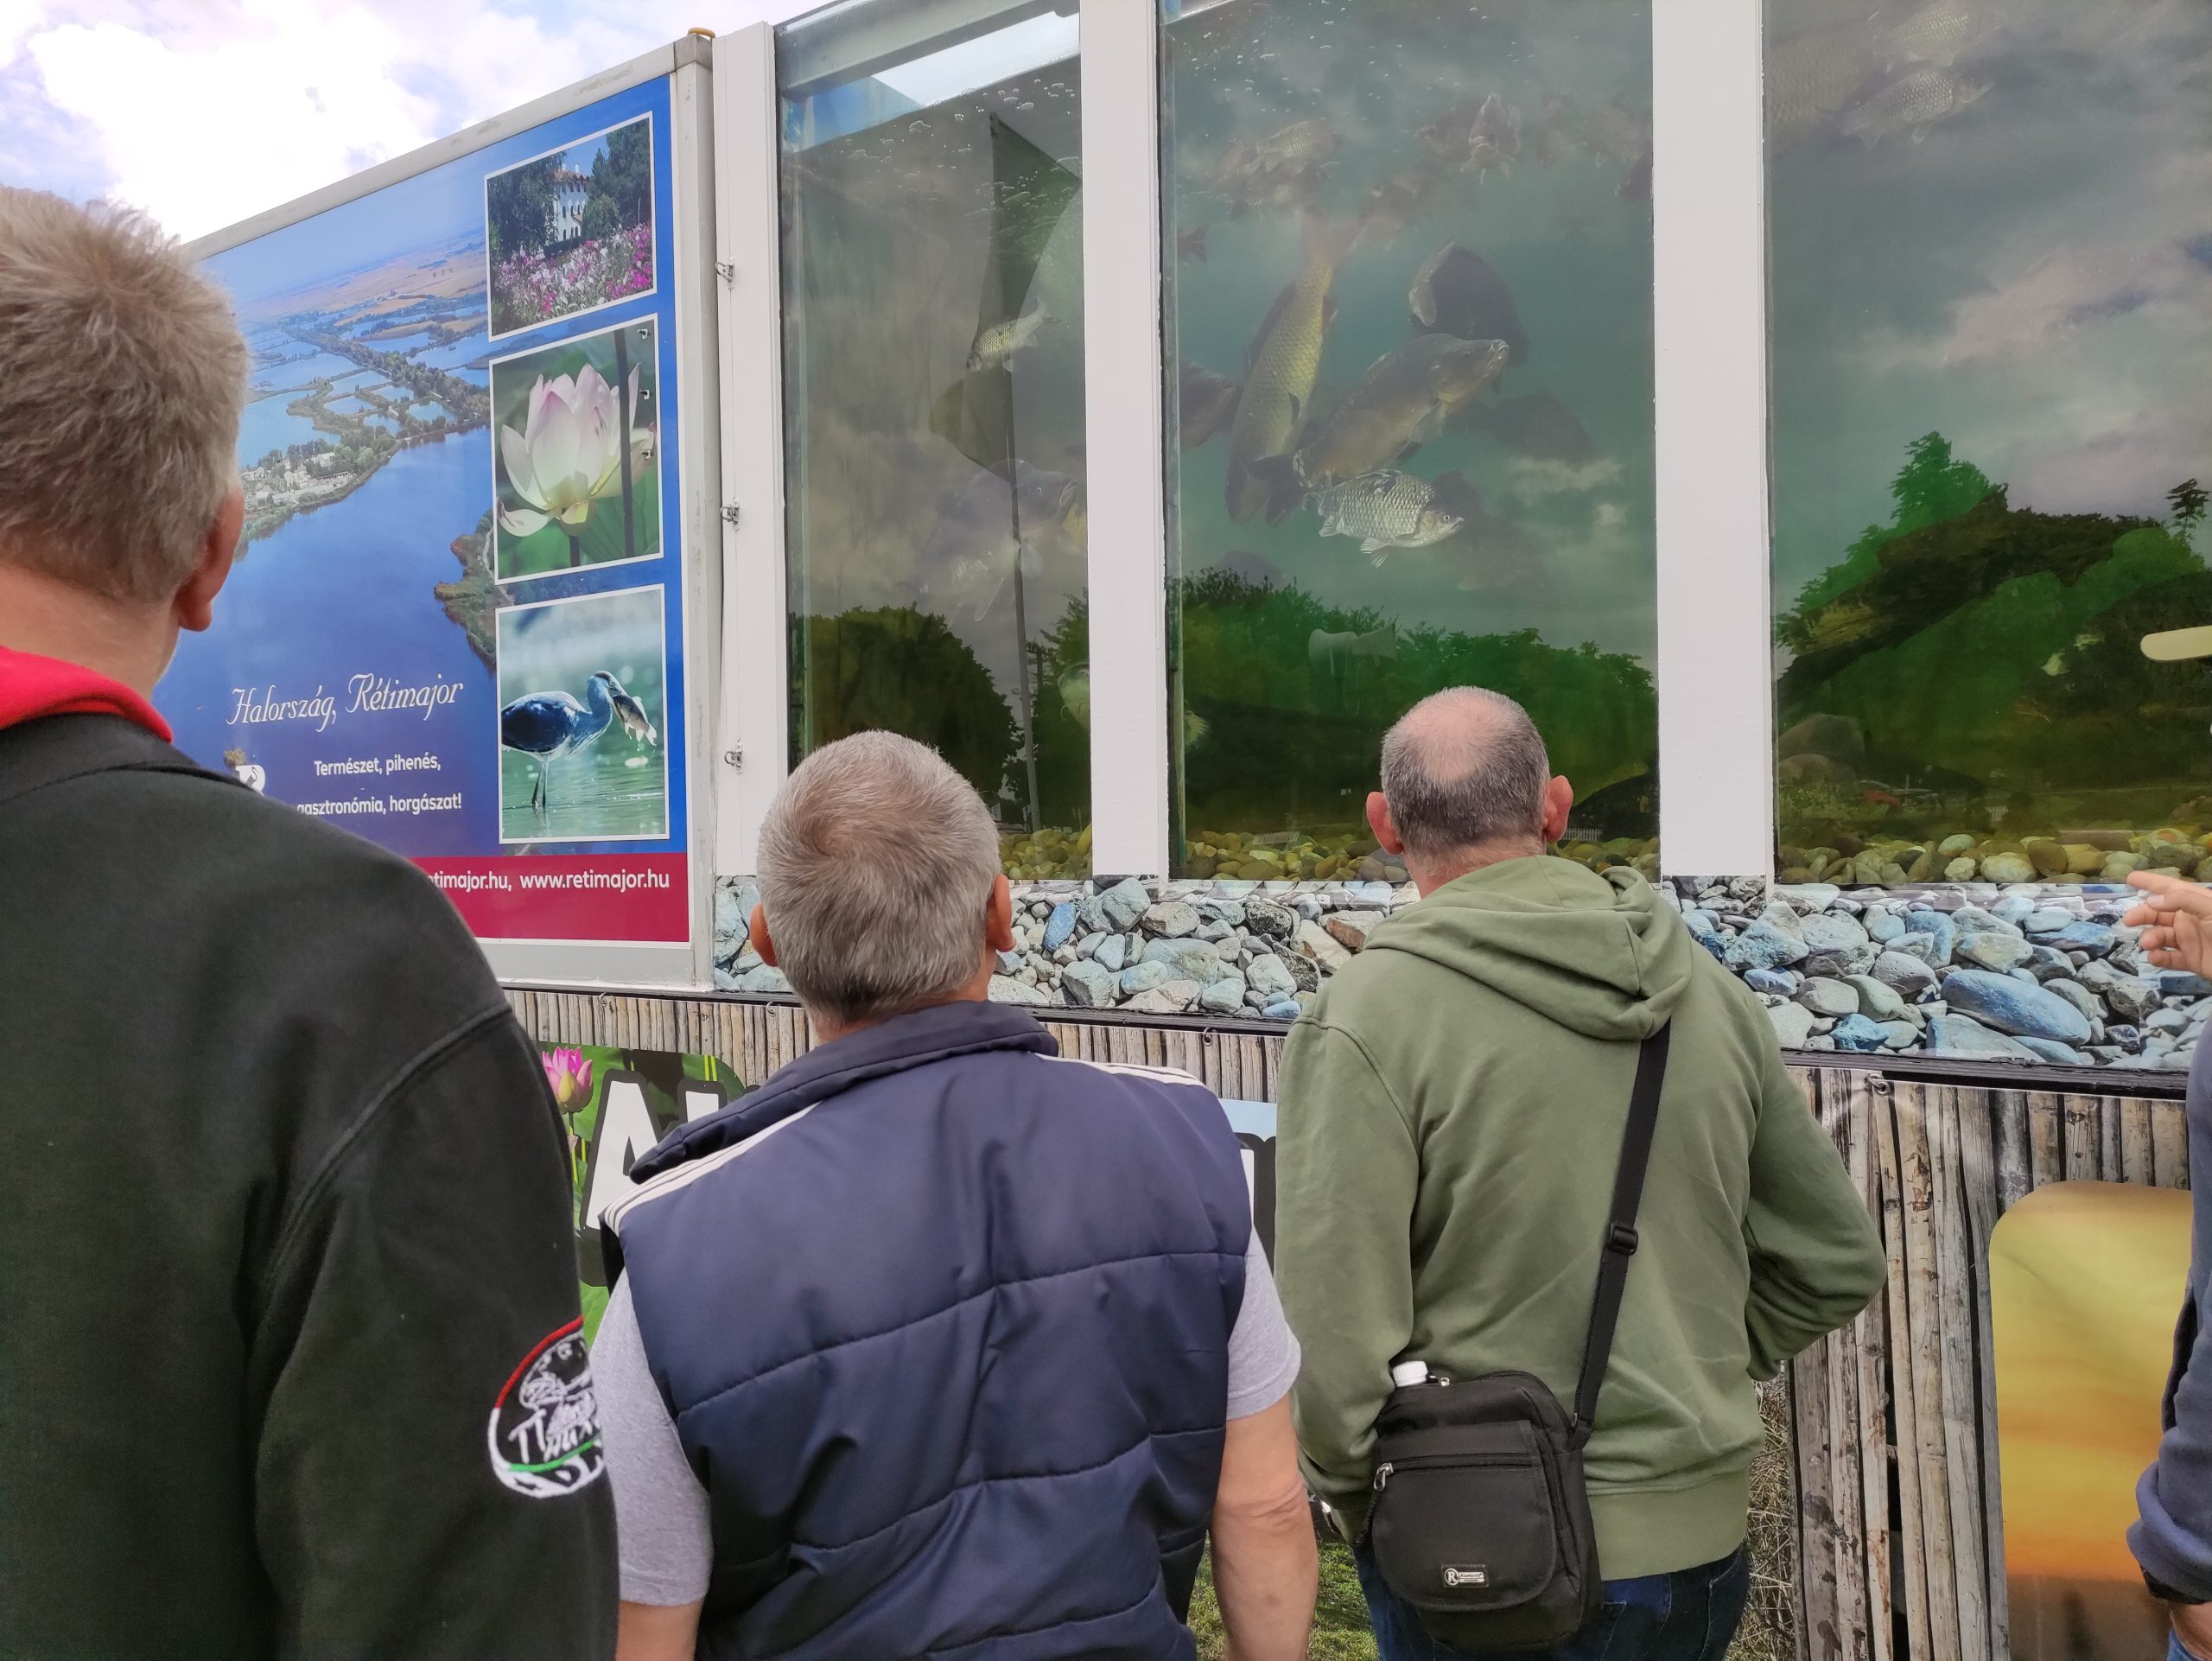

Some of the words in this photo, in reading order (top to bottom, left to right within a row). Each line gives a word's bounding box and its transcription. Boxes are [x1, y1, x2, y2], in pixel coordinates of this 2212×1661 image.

[226, 684, 337, 733] Halország,
[346, 672, 464, 721] Rétimajor
[314, 757, 383, 777] Természet,
[386, 751, 442, 776] pihenés,
[390, 792, 462, 815] horgászat!
[519, 868, 671, 893] www.retimajor.hu
